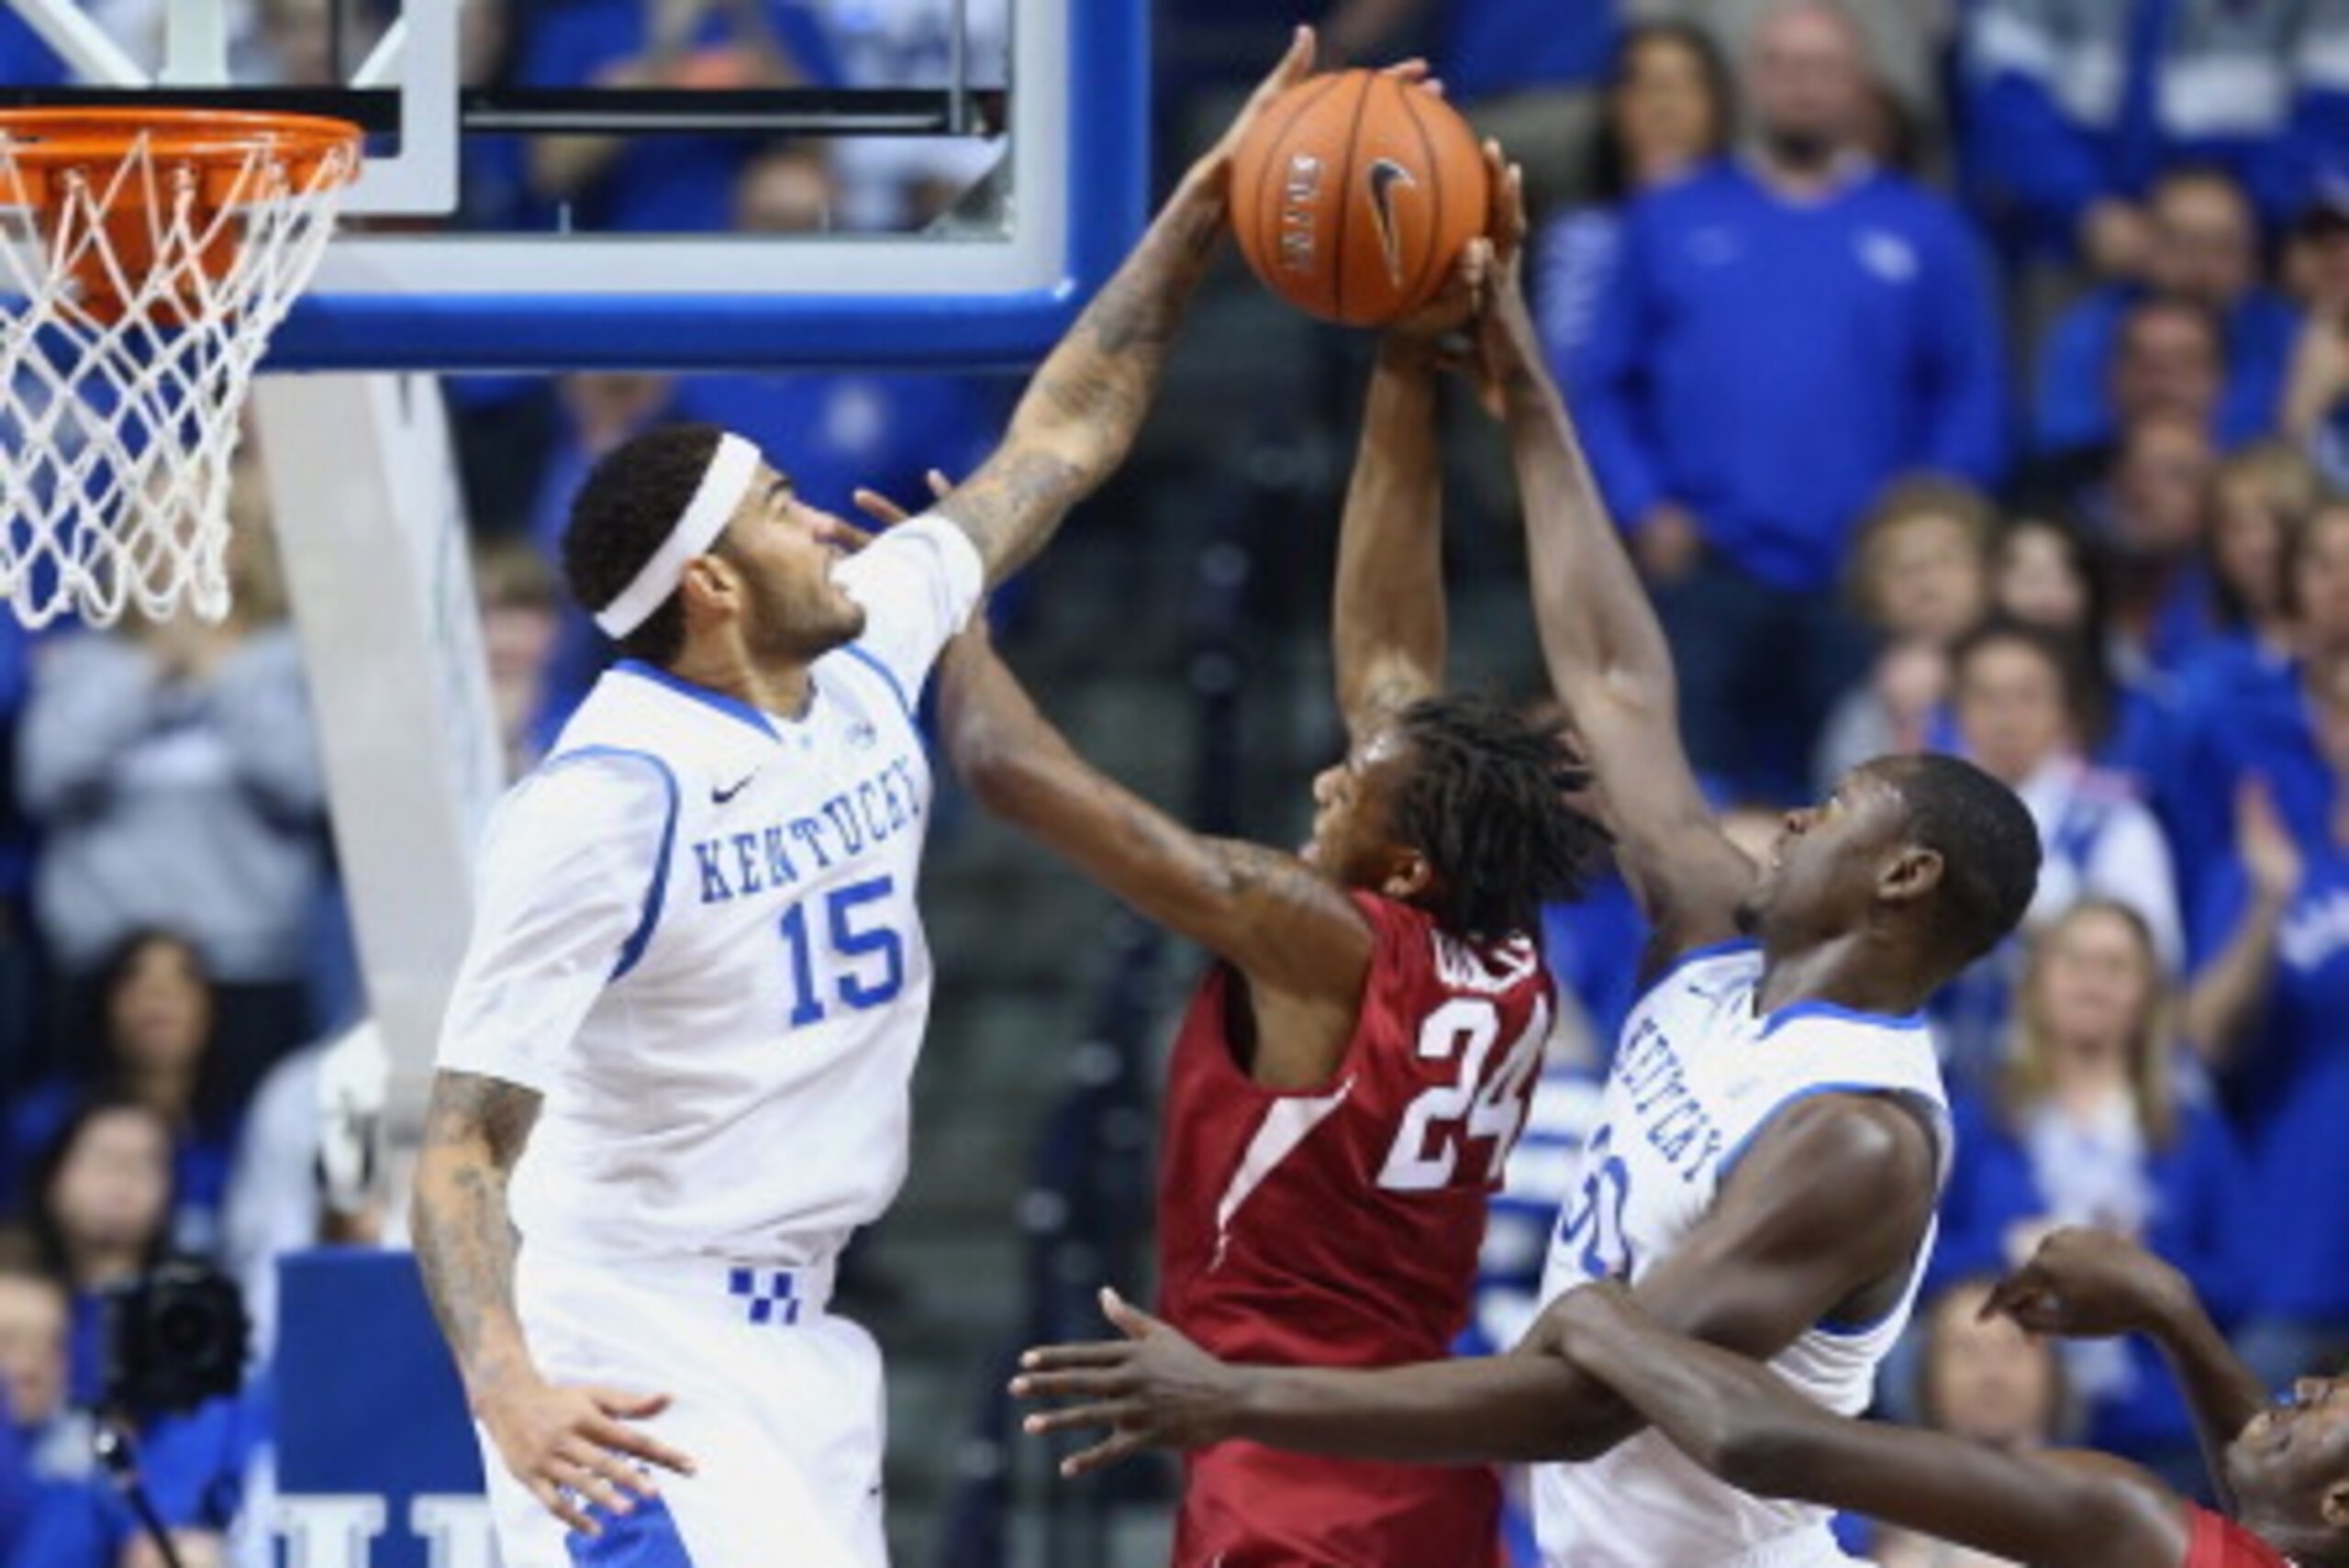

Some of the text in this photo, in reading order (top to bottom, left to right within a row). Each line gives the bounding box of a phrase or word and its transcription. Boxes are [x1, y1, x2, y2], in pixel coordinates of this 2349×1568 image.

[692, 754, 919, 904] KENTUCKY
[780, 873, 904, 1029] 15
[1376, 991, 1550, 1191] 24
